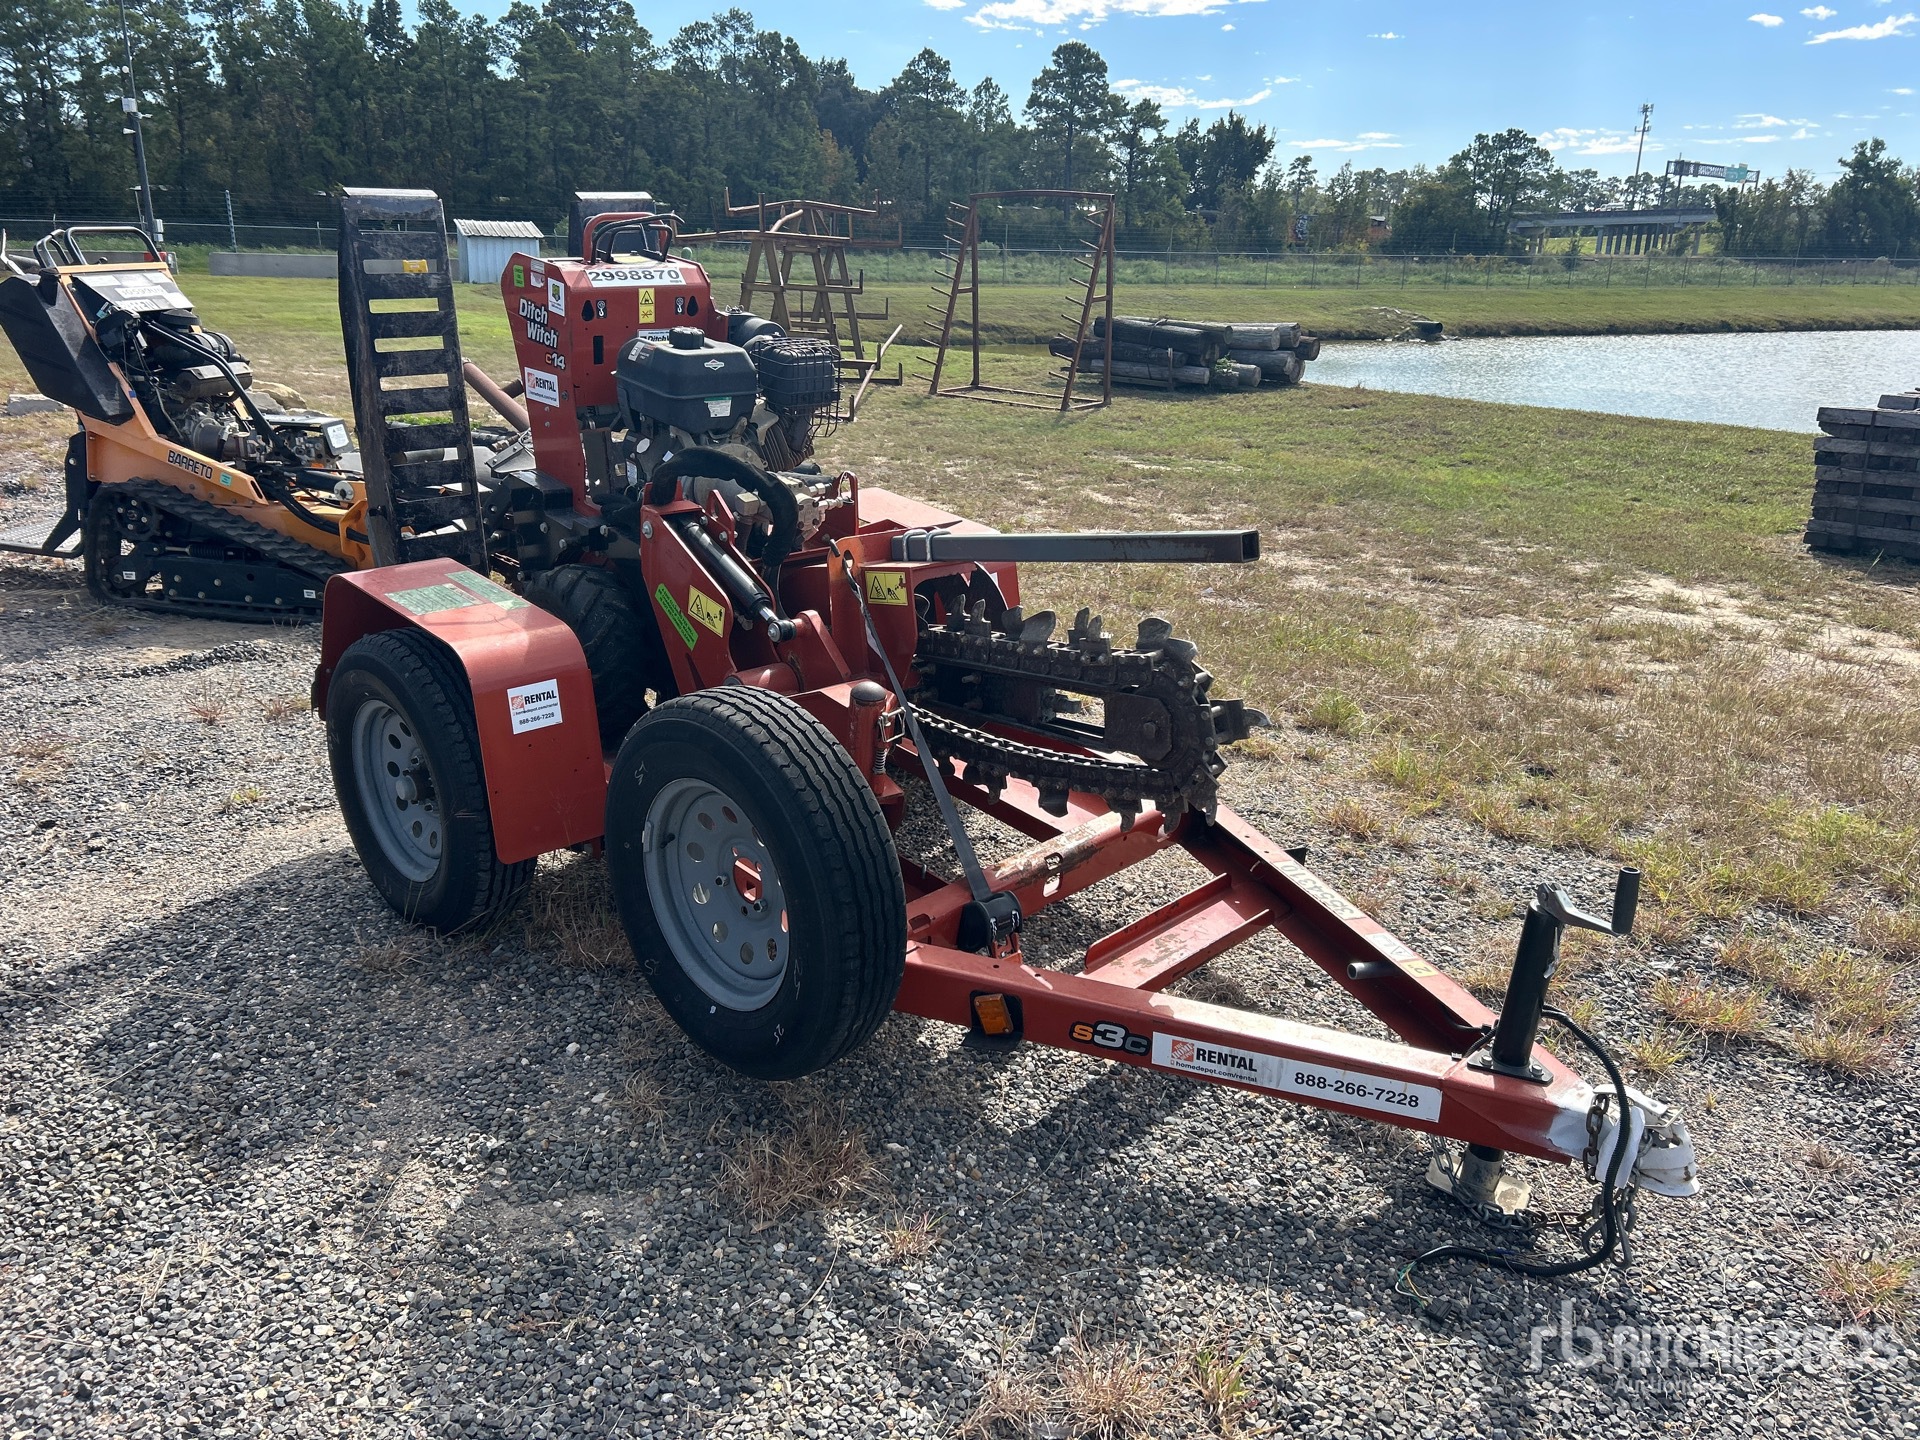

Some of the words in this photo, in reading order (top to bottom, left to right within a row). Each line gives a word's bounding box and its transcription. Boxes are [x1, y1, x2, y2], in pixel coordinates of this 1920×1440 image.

[588, 269, 680, 282] 2998870
[519, 298, 548, 325] Ditch
[527, 320, 559, 348] Witch
[535, 376, 557, 393] RENTAL
[168, 449, 213, 480] BARRETO
[524, 690, 558, 706] RENTAL
[1280, 864, 1355, 916] 3554310
[1171, 1043, 1193, 1060] HOME
[1196, 1047, 1258, 1072] RENTAL
[1175, 1061, 1258, 1083] homedepot.com/rental
[1294, 1072, 1420, 1108] 888-266-7228
